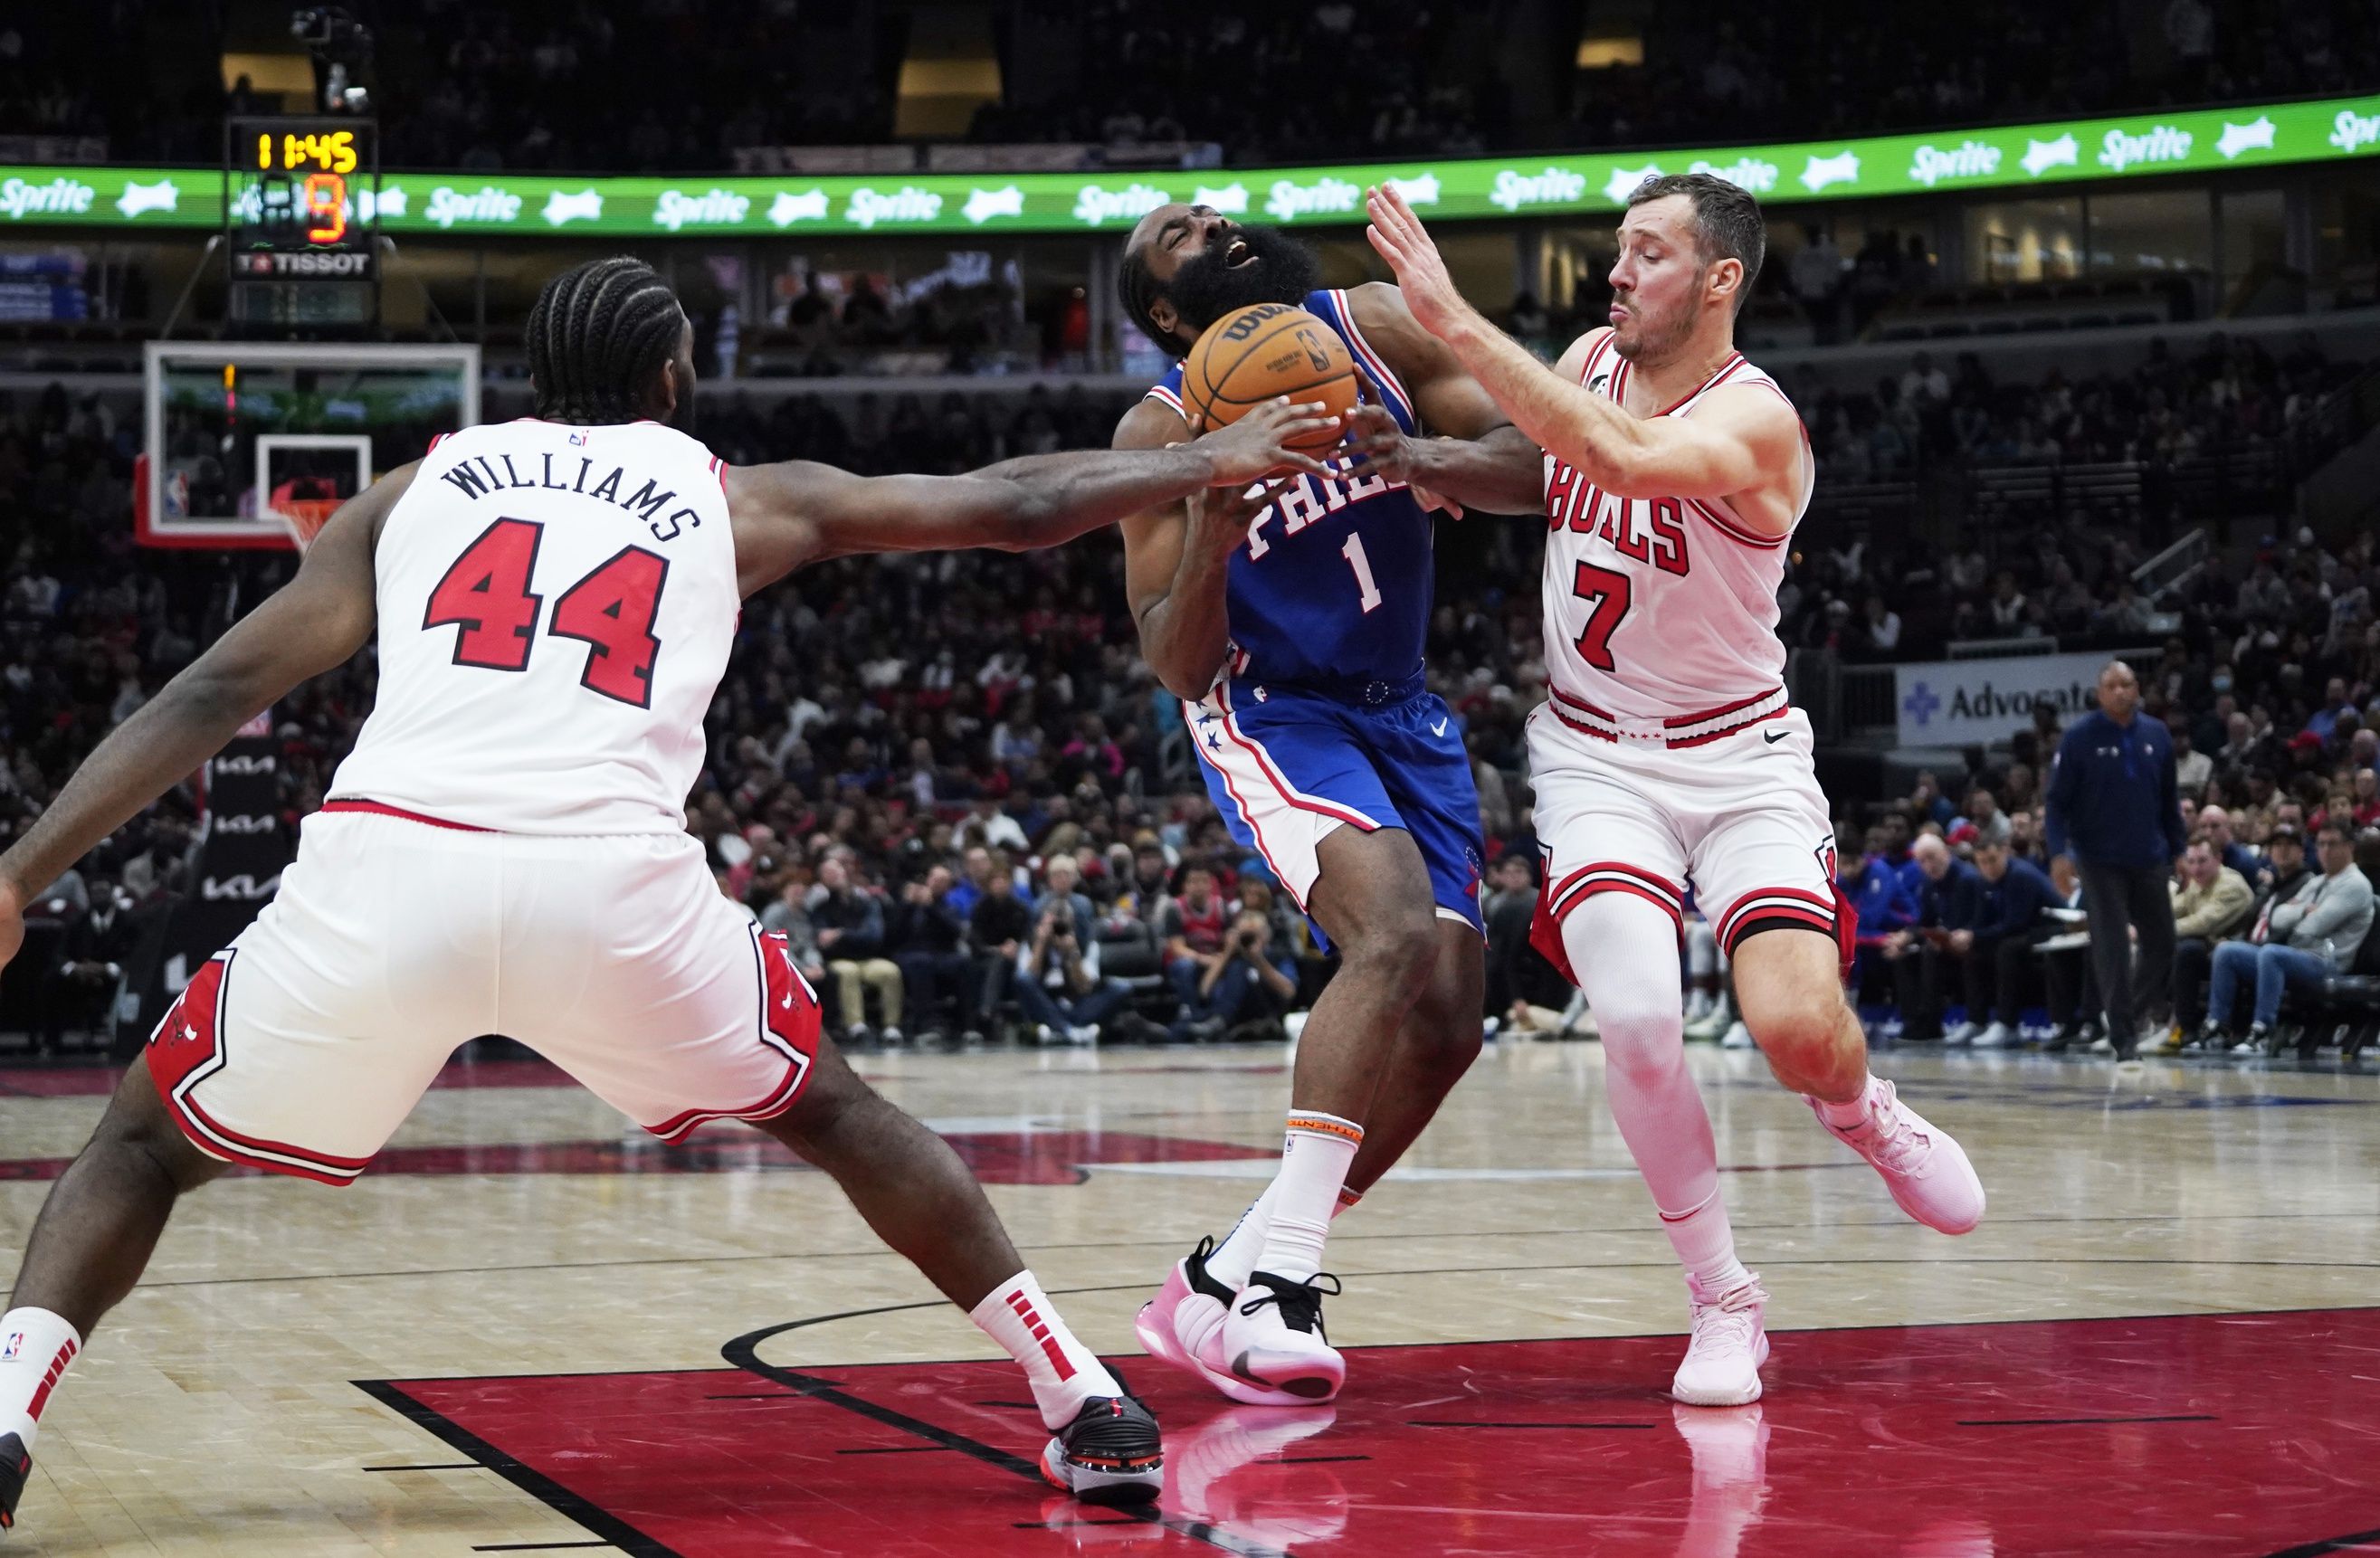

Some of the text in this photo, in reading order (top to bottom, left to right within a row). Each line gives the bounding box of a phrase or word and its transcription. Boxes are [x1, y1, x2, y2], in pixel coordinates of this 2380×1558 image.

[259, 131, 357, 174] 11:45
[1909, 140, 2002, 186] Sprite
[2099, 126, 2193, 172] Sprite
[0, 177, 94, 219] Sprite
[304, 173, 347, 243] 9
[424, 186, 522, 227] Sprite
[653, 188, 750, 231] Sprite
[846, 185, 943, 228] Sprite
[1264, 176, 1361, 222] Sprite
[1490, 166, 1586, 211] Sprite
[273, 252, 369, 275] TISSOT
[441, 452, 700, 542] WILLIAMS
[1242, 440, 1408, 564] PHIL
[1341, 530, 1382, 614] 1
[421, 516, 670, 710] 44
[1573, 559, 1631, 672] 7
